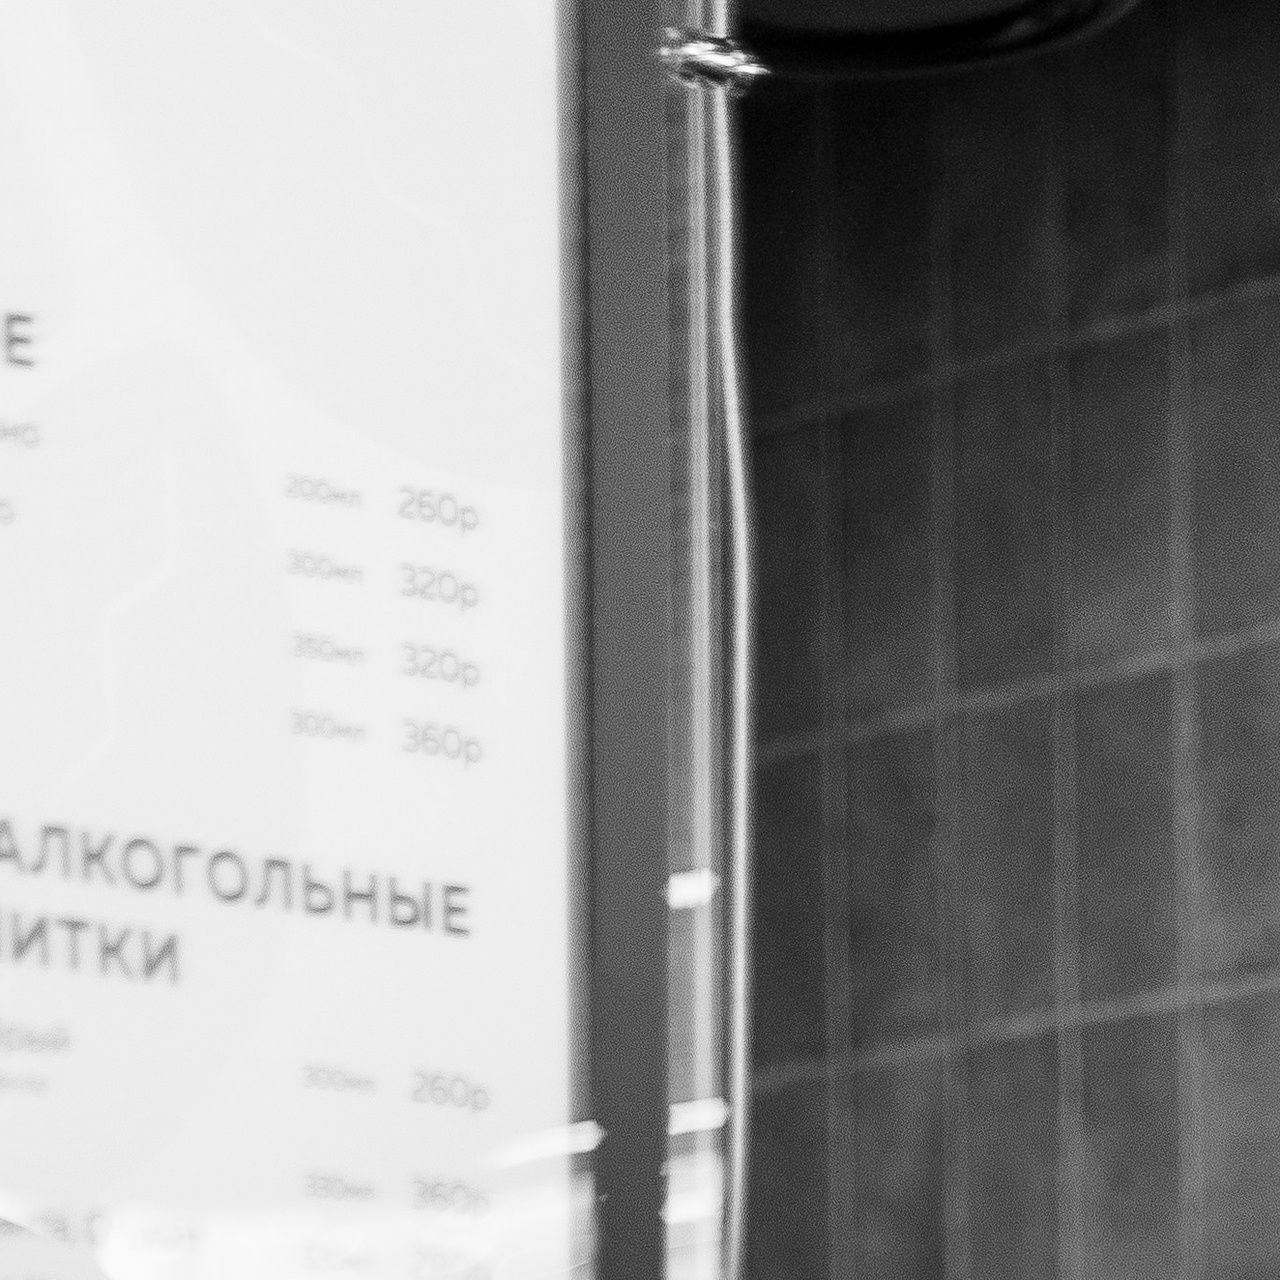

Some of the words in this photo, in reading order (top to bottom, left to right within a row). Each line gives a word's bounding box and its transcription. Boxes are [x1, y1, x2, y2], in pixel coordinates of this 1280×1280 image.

[398, 484, 479, 537] 260р
[400, 561, 479, 614] 320р
[401, 641, 480, 692] 320р
[402, 717, 483, 769] 360р
[411, 1067, 490, 1117] 260р
